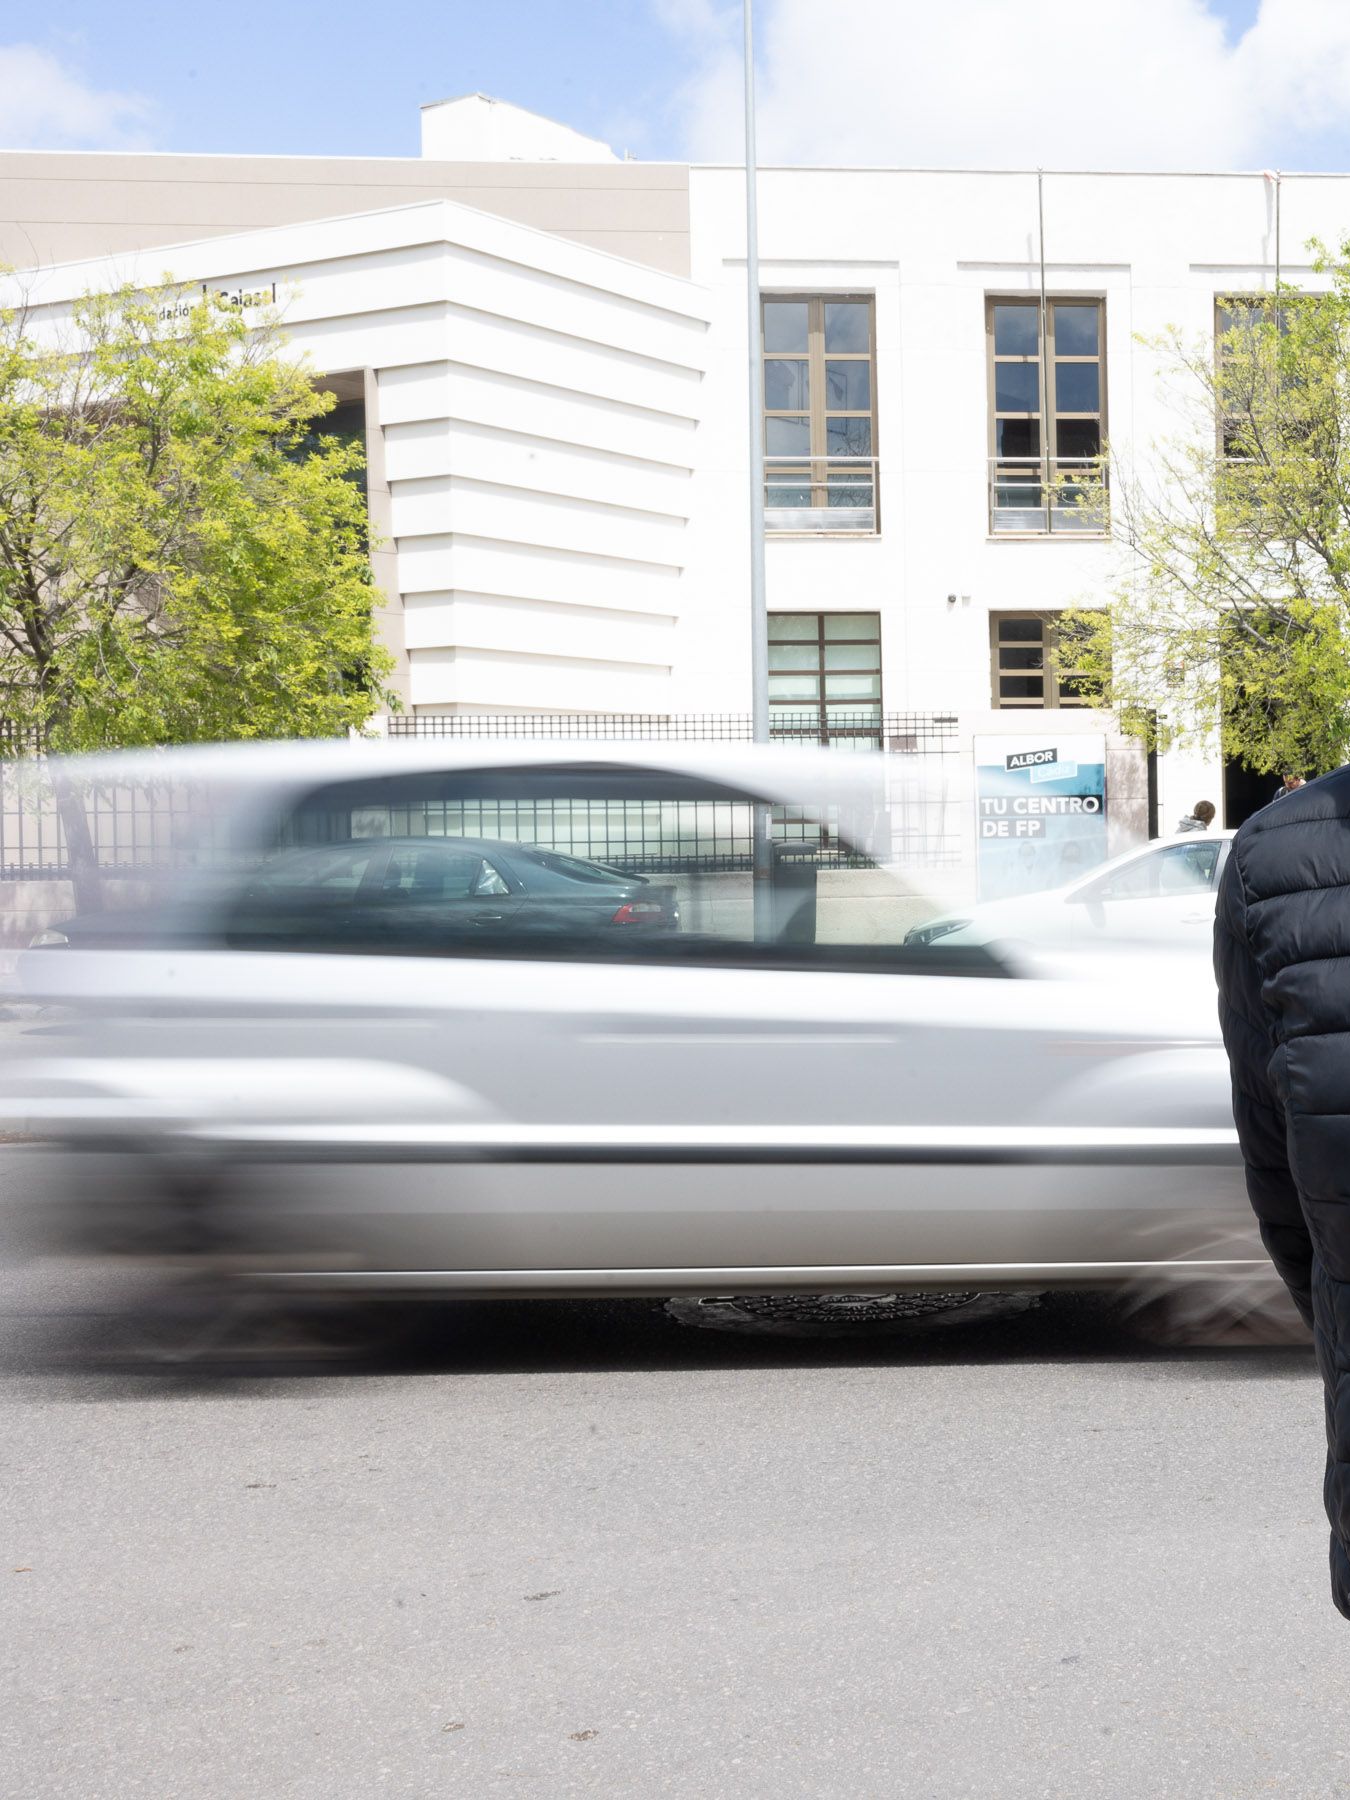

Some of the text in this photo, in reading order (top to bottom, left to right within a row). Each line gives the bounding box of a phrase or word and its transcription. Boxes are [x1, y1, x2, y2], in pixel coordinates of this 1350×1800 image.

[213, 282, 276, 316] Cajasl
[1009, 751, 1054, 768] ALBOR
[982, 796, 1100, 815] TU CENTRO
[982, 820, 1041, 838] DE FP
